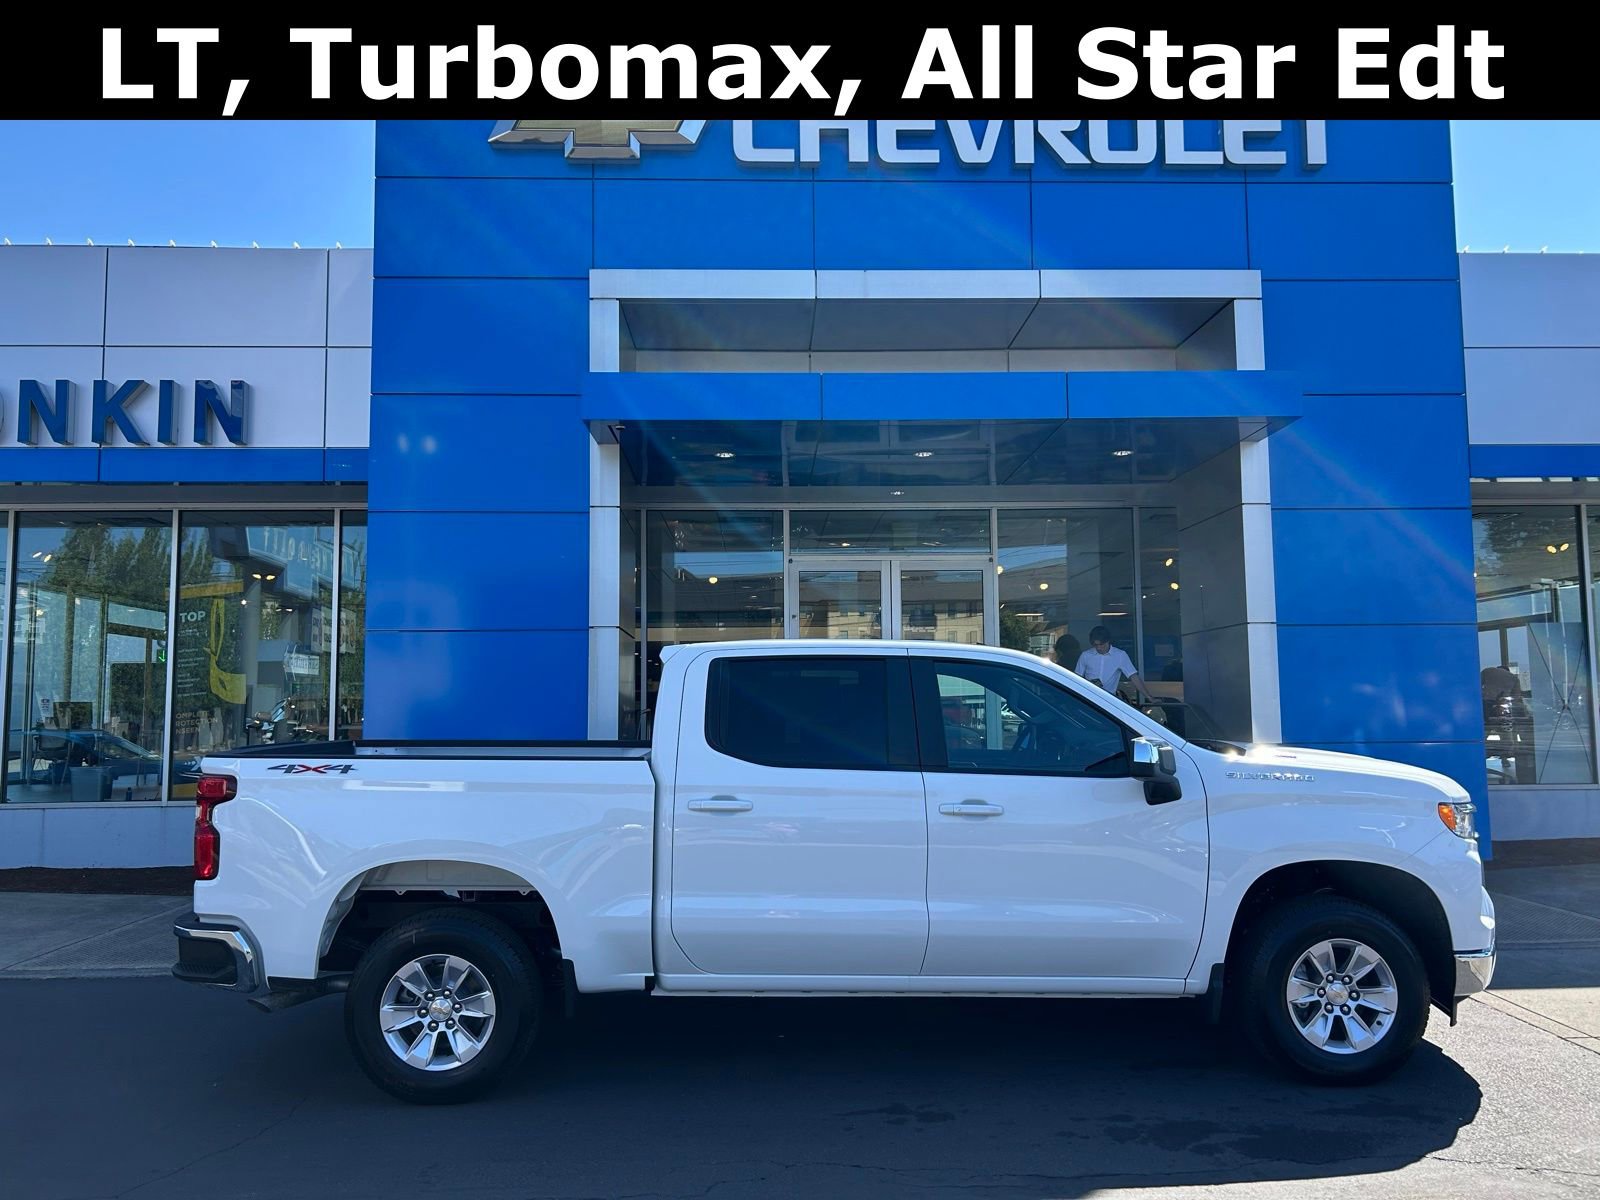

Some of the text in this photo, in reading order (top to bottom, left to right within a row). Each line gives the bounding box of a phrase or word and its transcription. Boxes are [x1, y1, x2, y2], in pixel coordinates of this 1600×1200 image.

[0, 379, 251, 445] NKIN
[179, 611, 206, 624] TOP
[175, 717, 218, 727] ROTECTION
